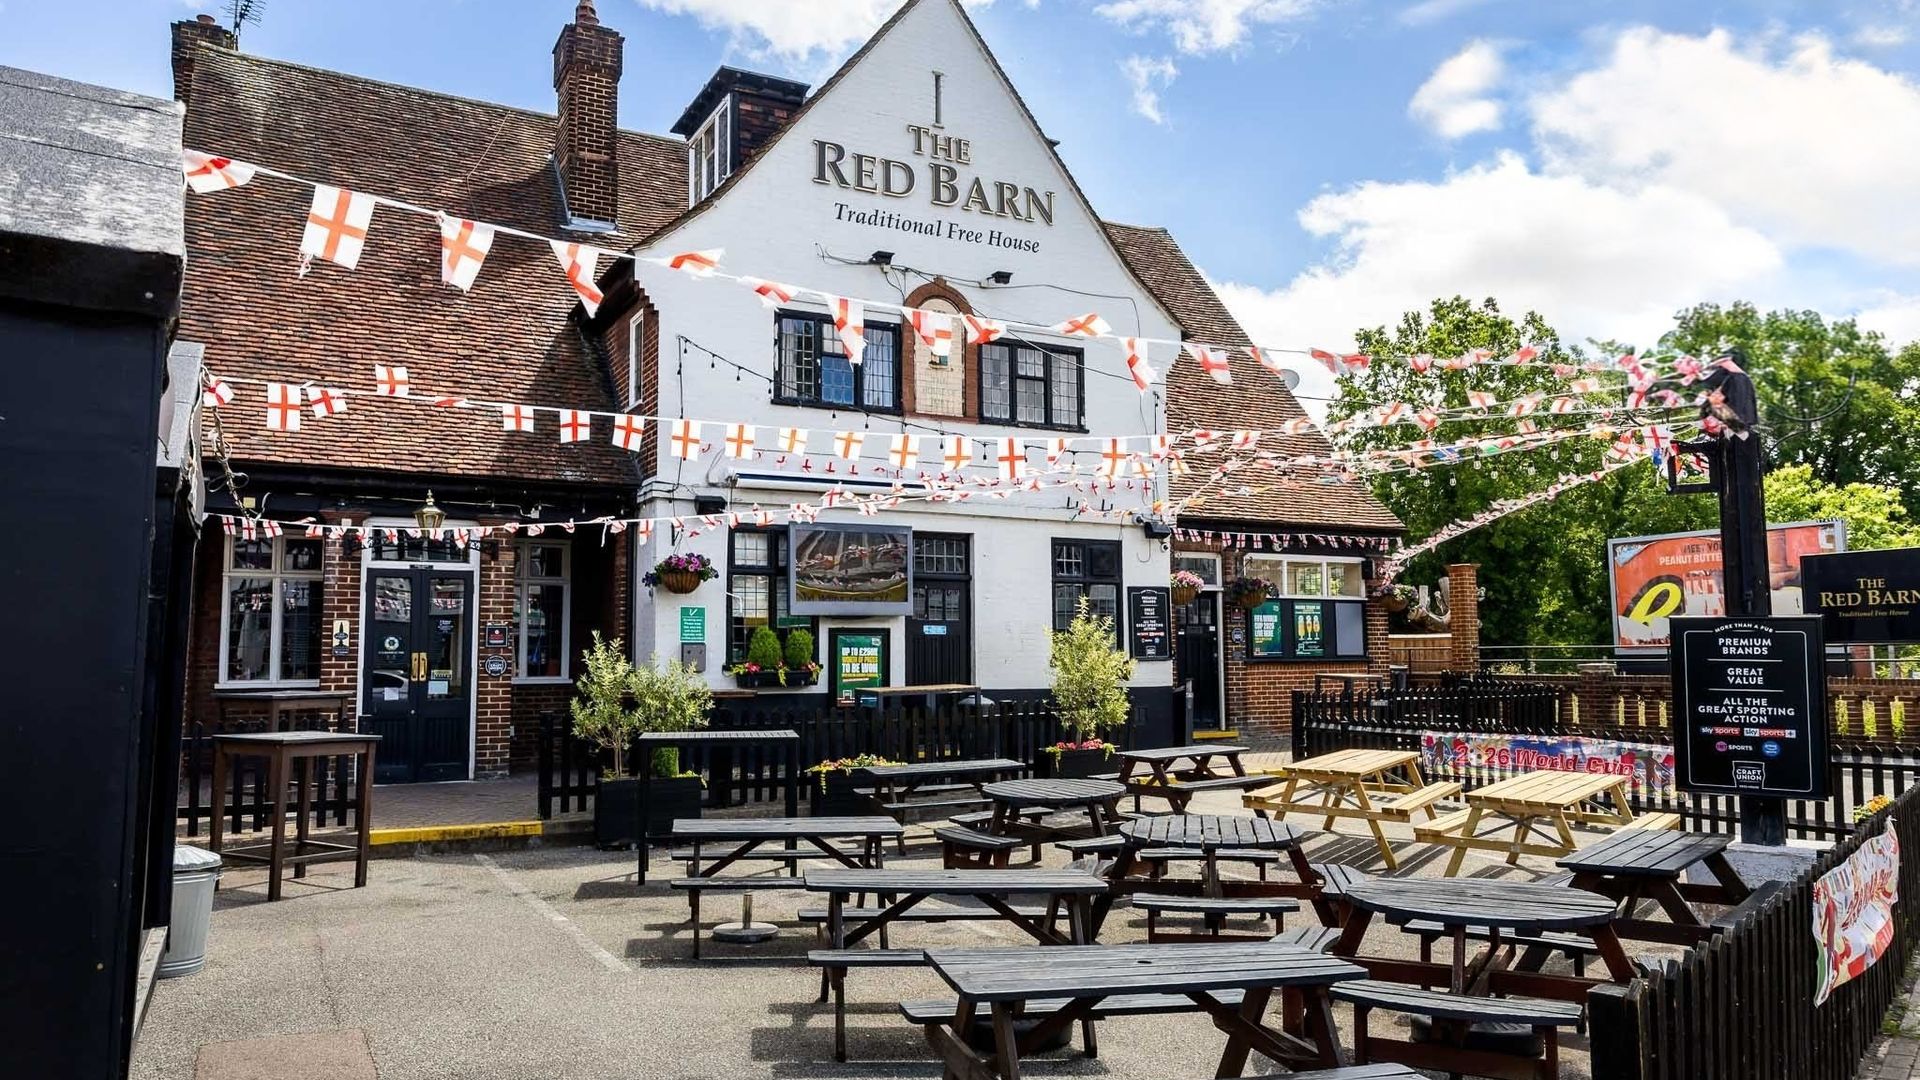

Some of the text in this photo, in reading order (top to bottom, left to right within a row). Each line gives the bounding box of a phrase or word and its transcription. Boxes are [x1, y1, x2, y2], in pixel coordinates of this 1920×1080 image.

[907, 124, 972, 164] THE
[811, 139, 1056, 227] RED BARN
[834, 202, 1040, 254] Traditional Free House
[1659, 553, 1722, 566] PEANUT BUTTE
[1856, 578, 1886, 589] THE
[1819, 590, 1920, 607] RED BARN
[1714, 623, 1733, 633] MORE
[1760, 625, 1774, 633] PUB
[1718, 637, 1772, 646] PREMIUM
[1722, 646, 1768, 655] BRANDS
[1727, 667, 1764, 676] GREAT
[1727, 676, 1764, 685] VALUE
[1723, 697, 1768, 706] ALL THE
[1698, 705, 1795, 716] GREAT SPORTING
[1724, 715, 1768, 724] ACTION
[1714, 727, 1739, 736] sports
[1514, 748, 1579, 771] World
[1585, 755, 1634, 776] Cup
